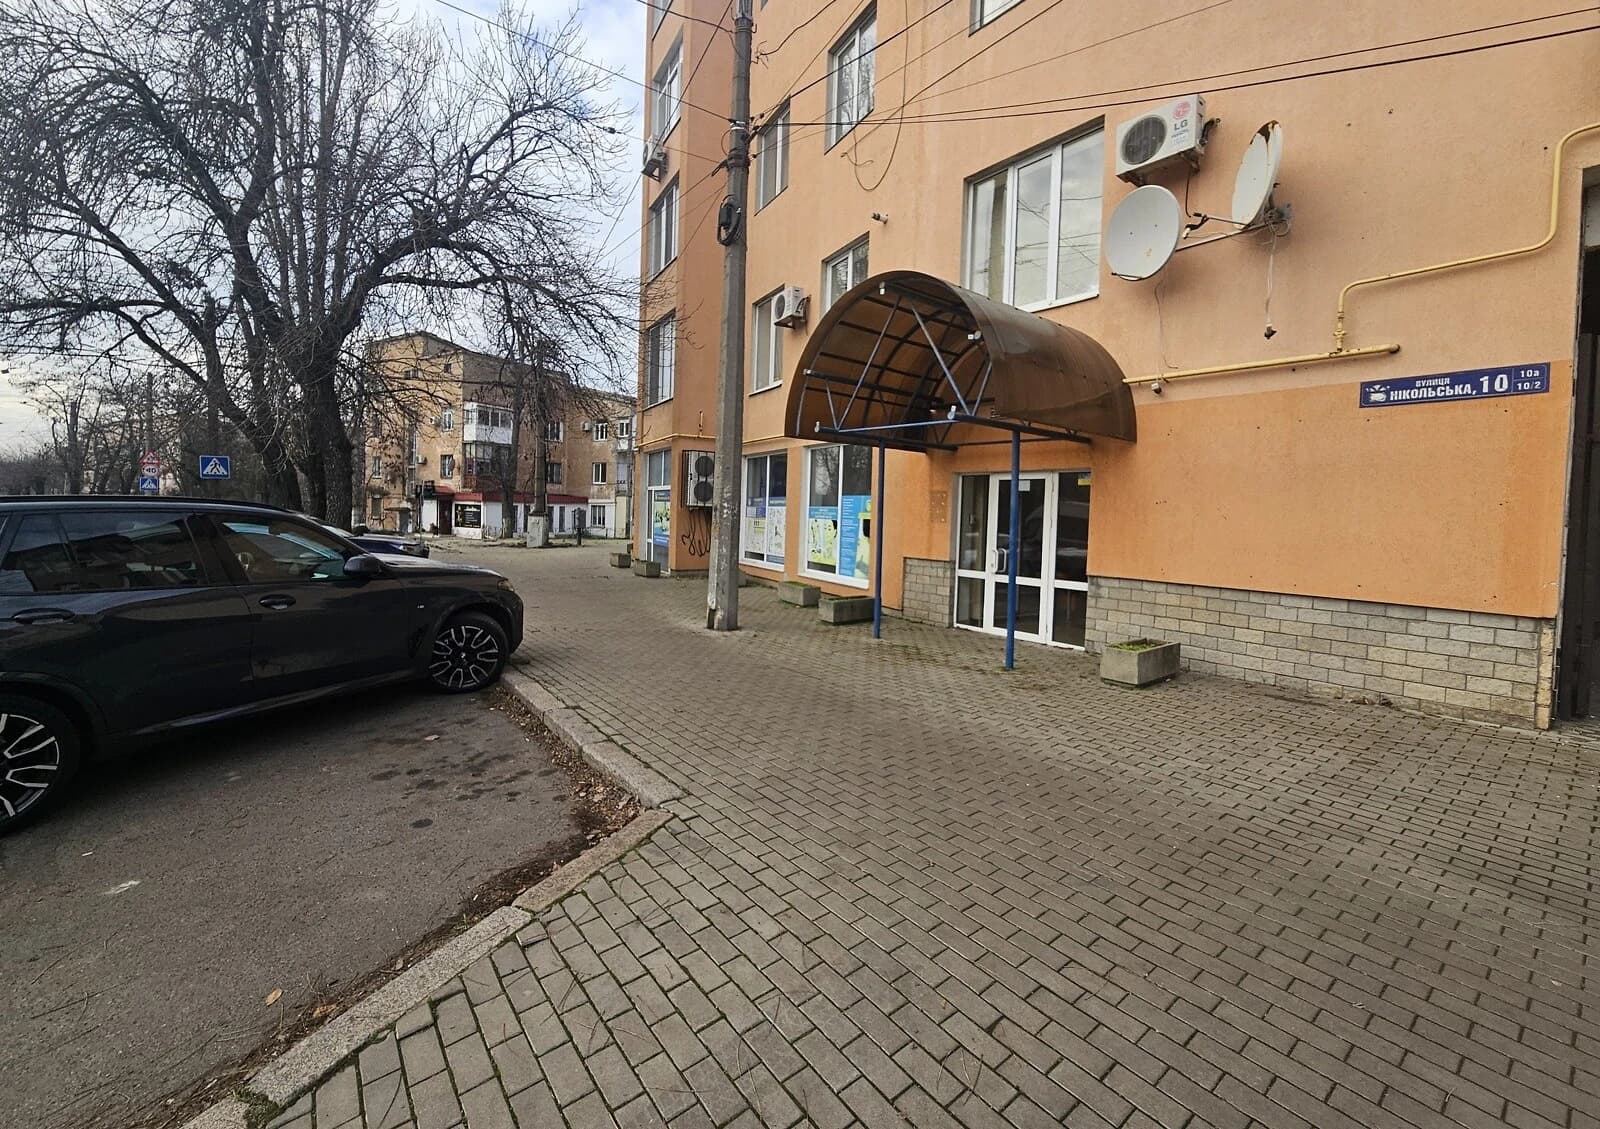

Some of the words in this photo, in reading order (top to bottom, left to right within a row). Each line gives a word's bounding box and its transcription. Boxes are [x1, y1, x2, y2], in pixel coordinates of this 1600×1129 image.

[1174, 119, 1188, 130] LG
[1390, 384, 1477, 401] НІКОЛЬСЬКА,
[1479, 373, 1509, 393] 10
[1516, 380, 1541, 390] 10/2
